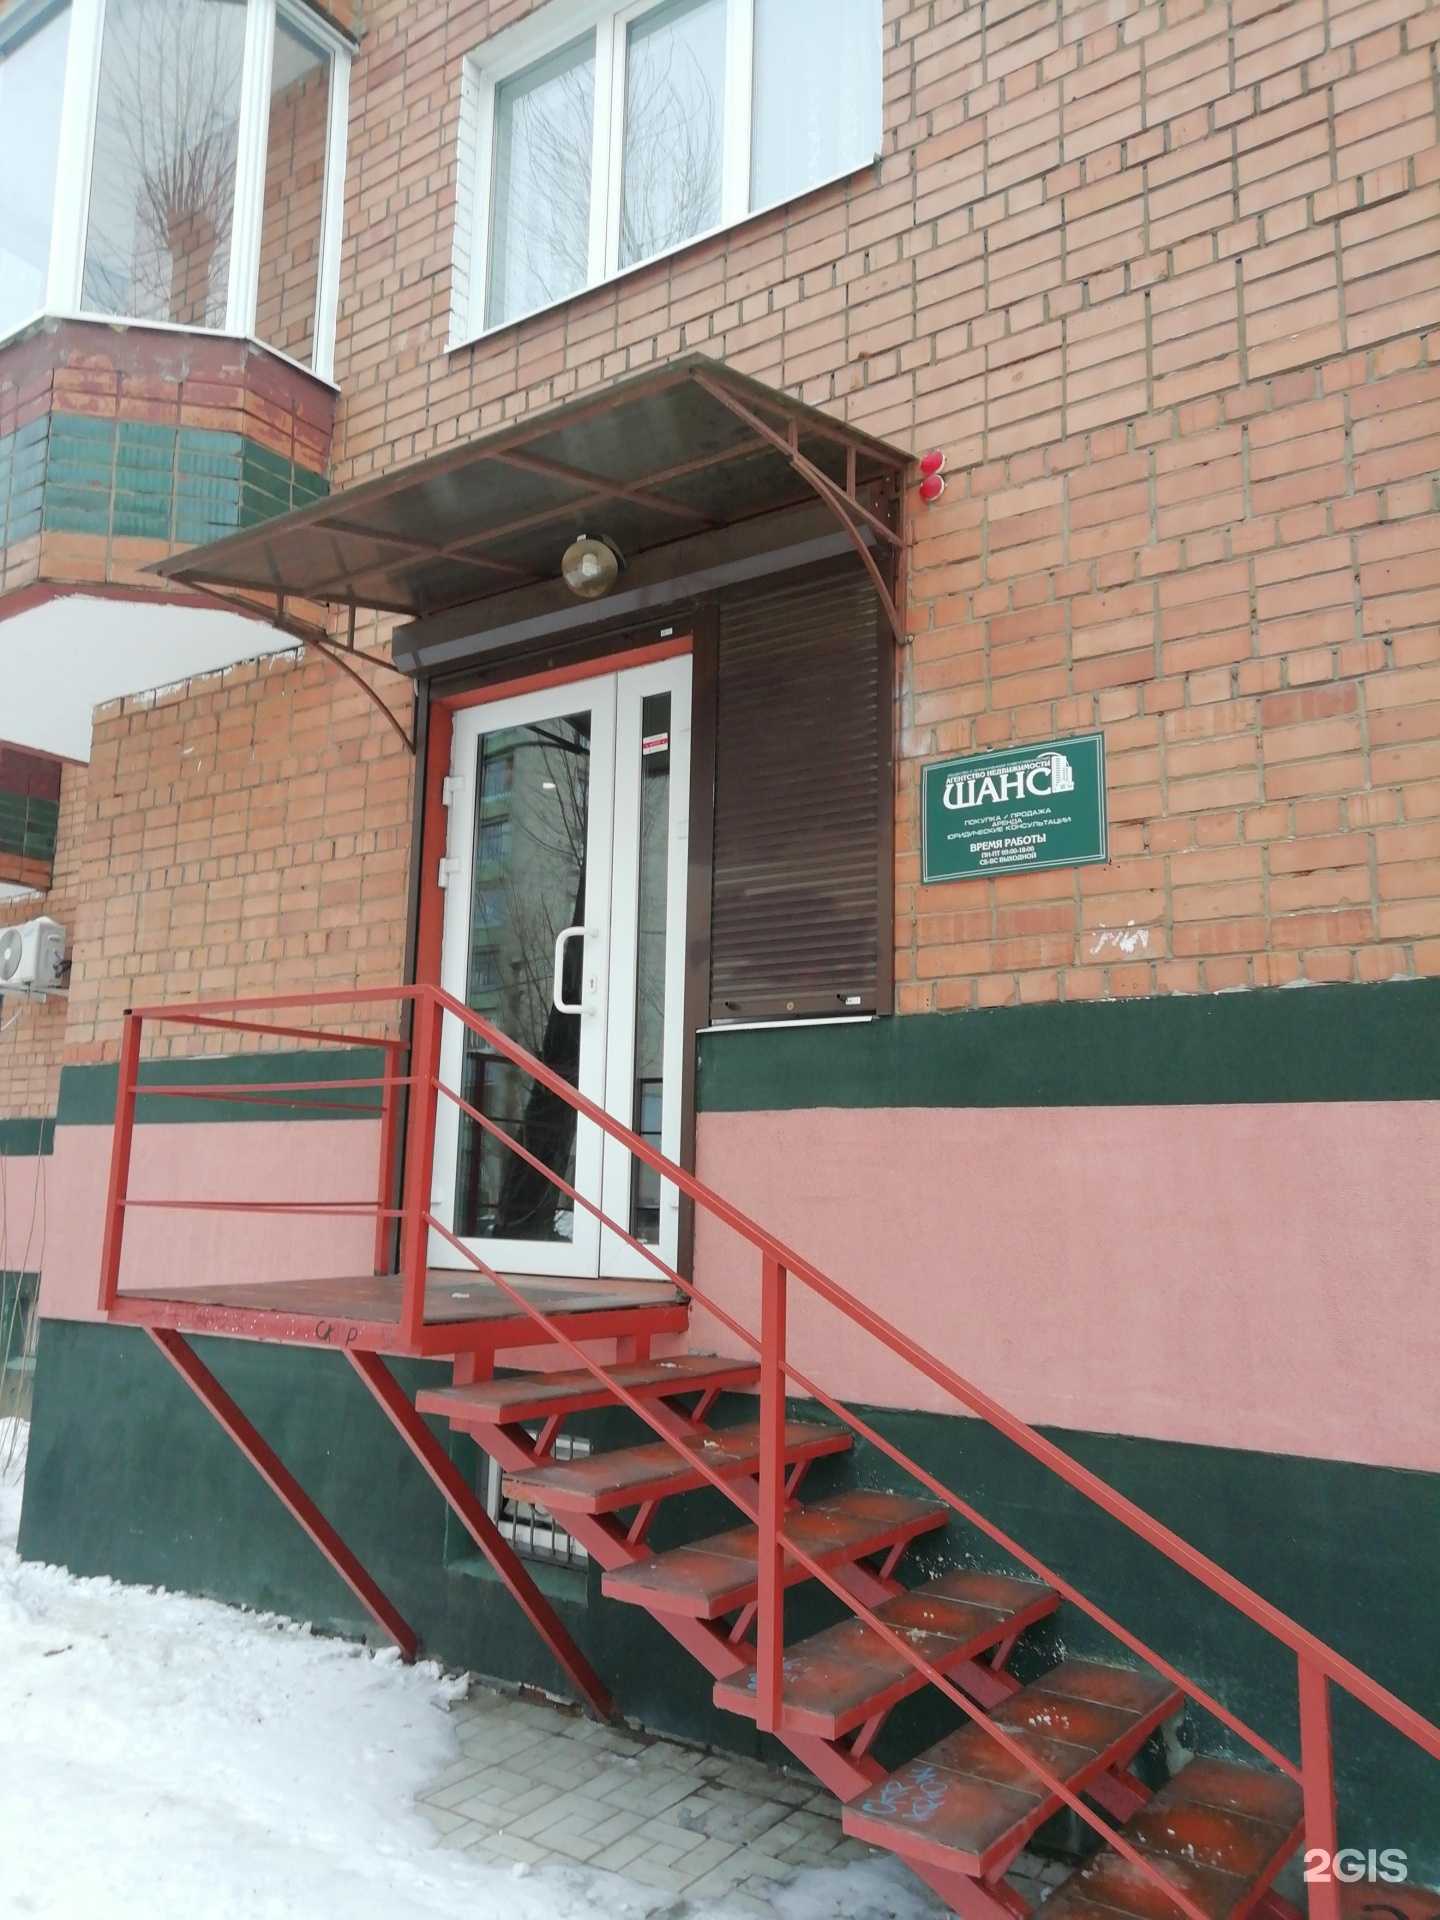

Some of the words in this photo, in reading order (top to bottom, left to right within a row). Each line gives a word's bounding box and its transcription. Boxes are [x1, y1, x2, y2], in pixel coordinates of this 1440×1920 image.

[945, 771, 986, 785] АГЕНТСТВО
[986, 759, 1051, 777] НЕДВИЖИМОСТИ
[943, 767, 1052, 809] ШАНС
[964, 815, 1002, 826] ПОКУПКА
[1010, 807, 1052, 818] ПРОДАЖА
[991, 817, 1023, 828] АРЕНДА
[969, 839, 1003, 853] ВРЕМЯ
[1003, 833, 1047, 848] РАБОТЫ
